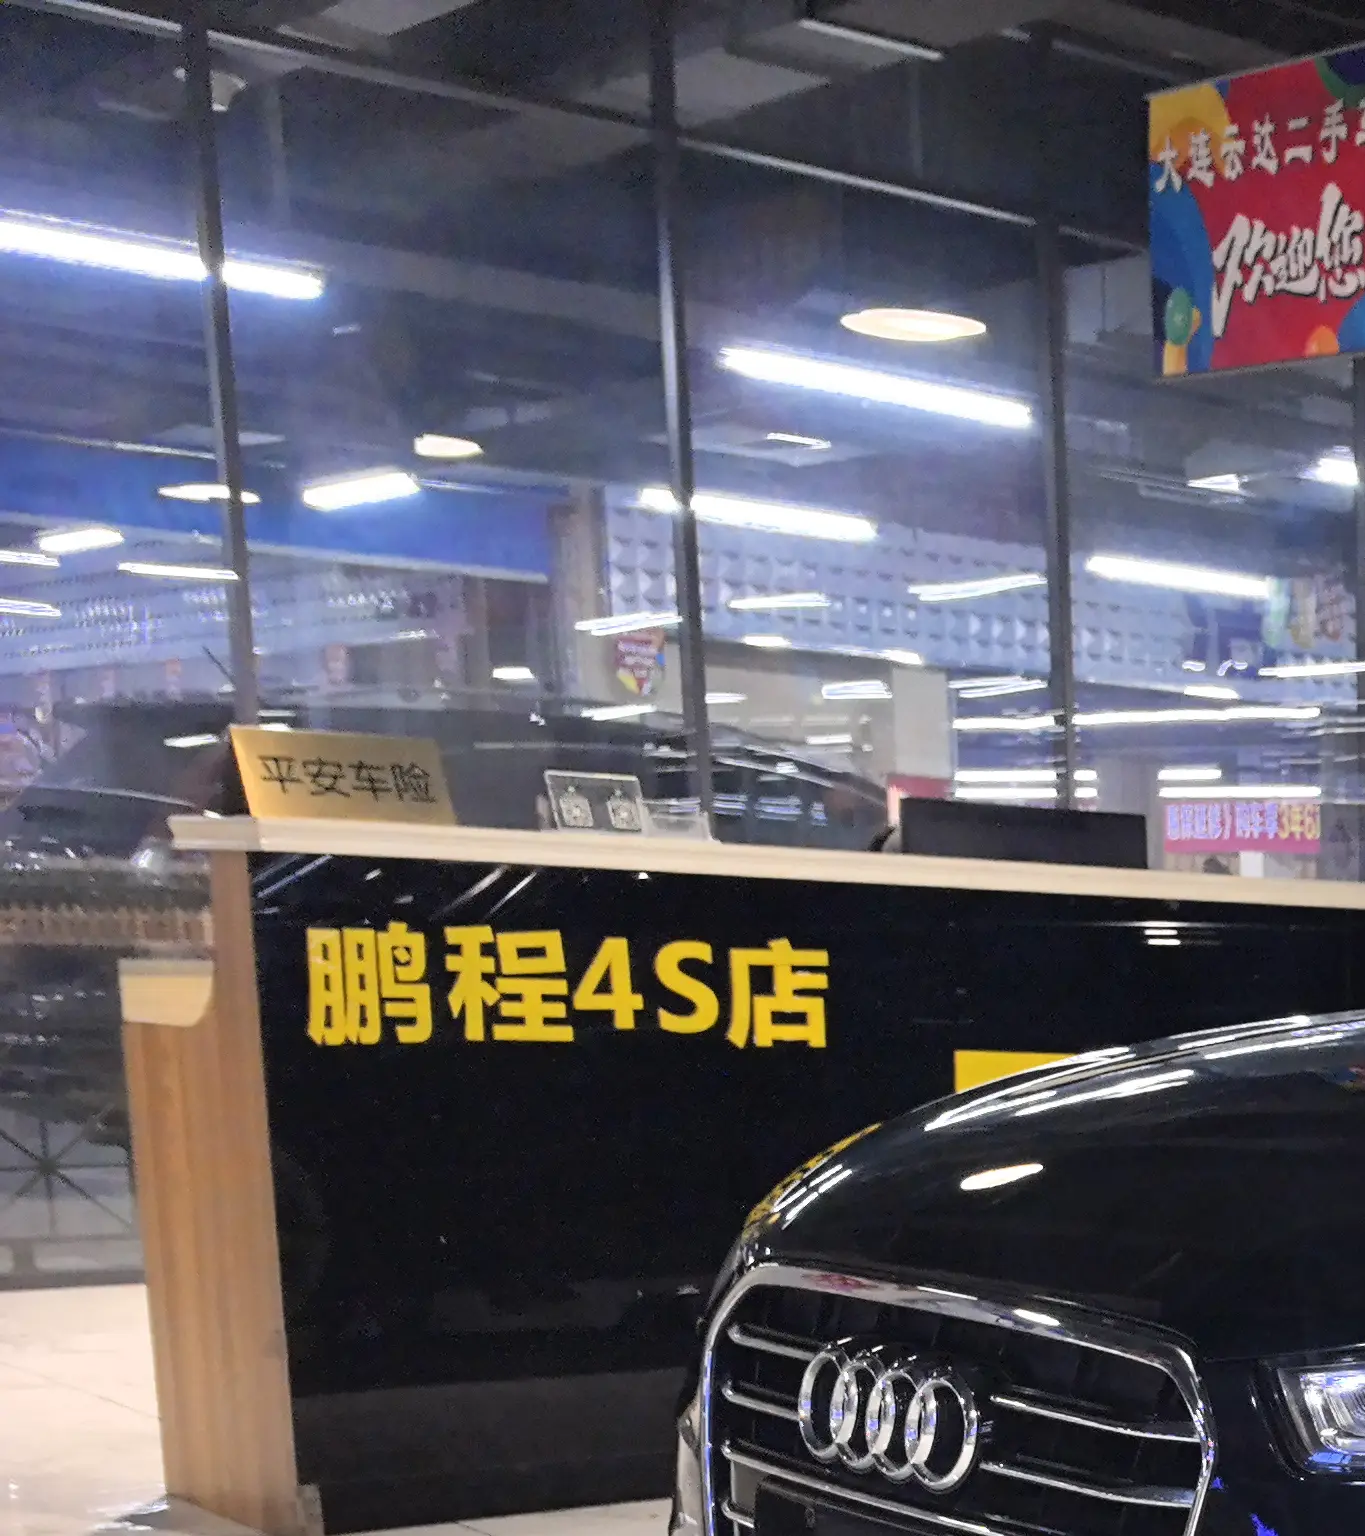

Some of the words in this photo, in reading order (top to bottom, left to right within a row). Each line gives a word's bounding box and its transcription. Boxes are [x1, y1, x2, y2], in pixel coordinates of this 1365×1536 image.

[257, 754, 438, 803] 平安车险
[306, 921, 831, 1049] 鹏程4S店
